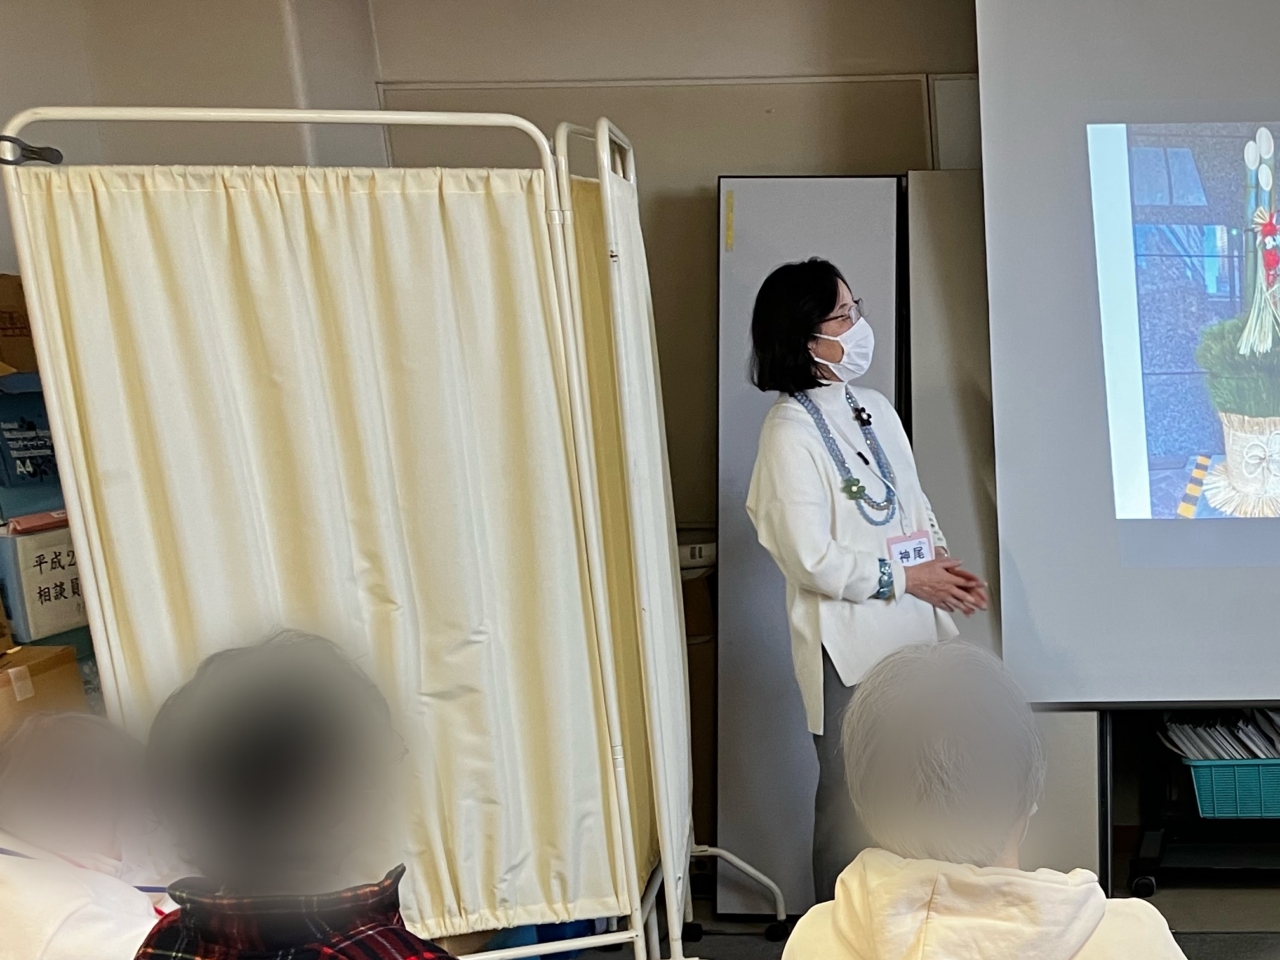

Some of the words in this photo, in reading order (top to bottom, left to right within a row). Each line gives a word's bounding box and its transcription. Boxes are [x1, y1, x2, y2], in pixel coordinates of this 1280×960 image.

[16, 459, 34, 475] A4
[899, 546, 926, 564] 神尾
[37, 577, 81, 605] 相談員
